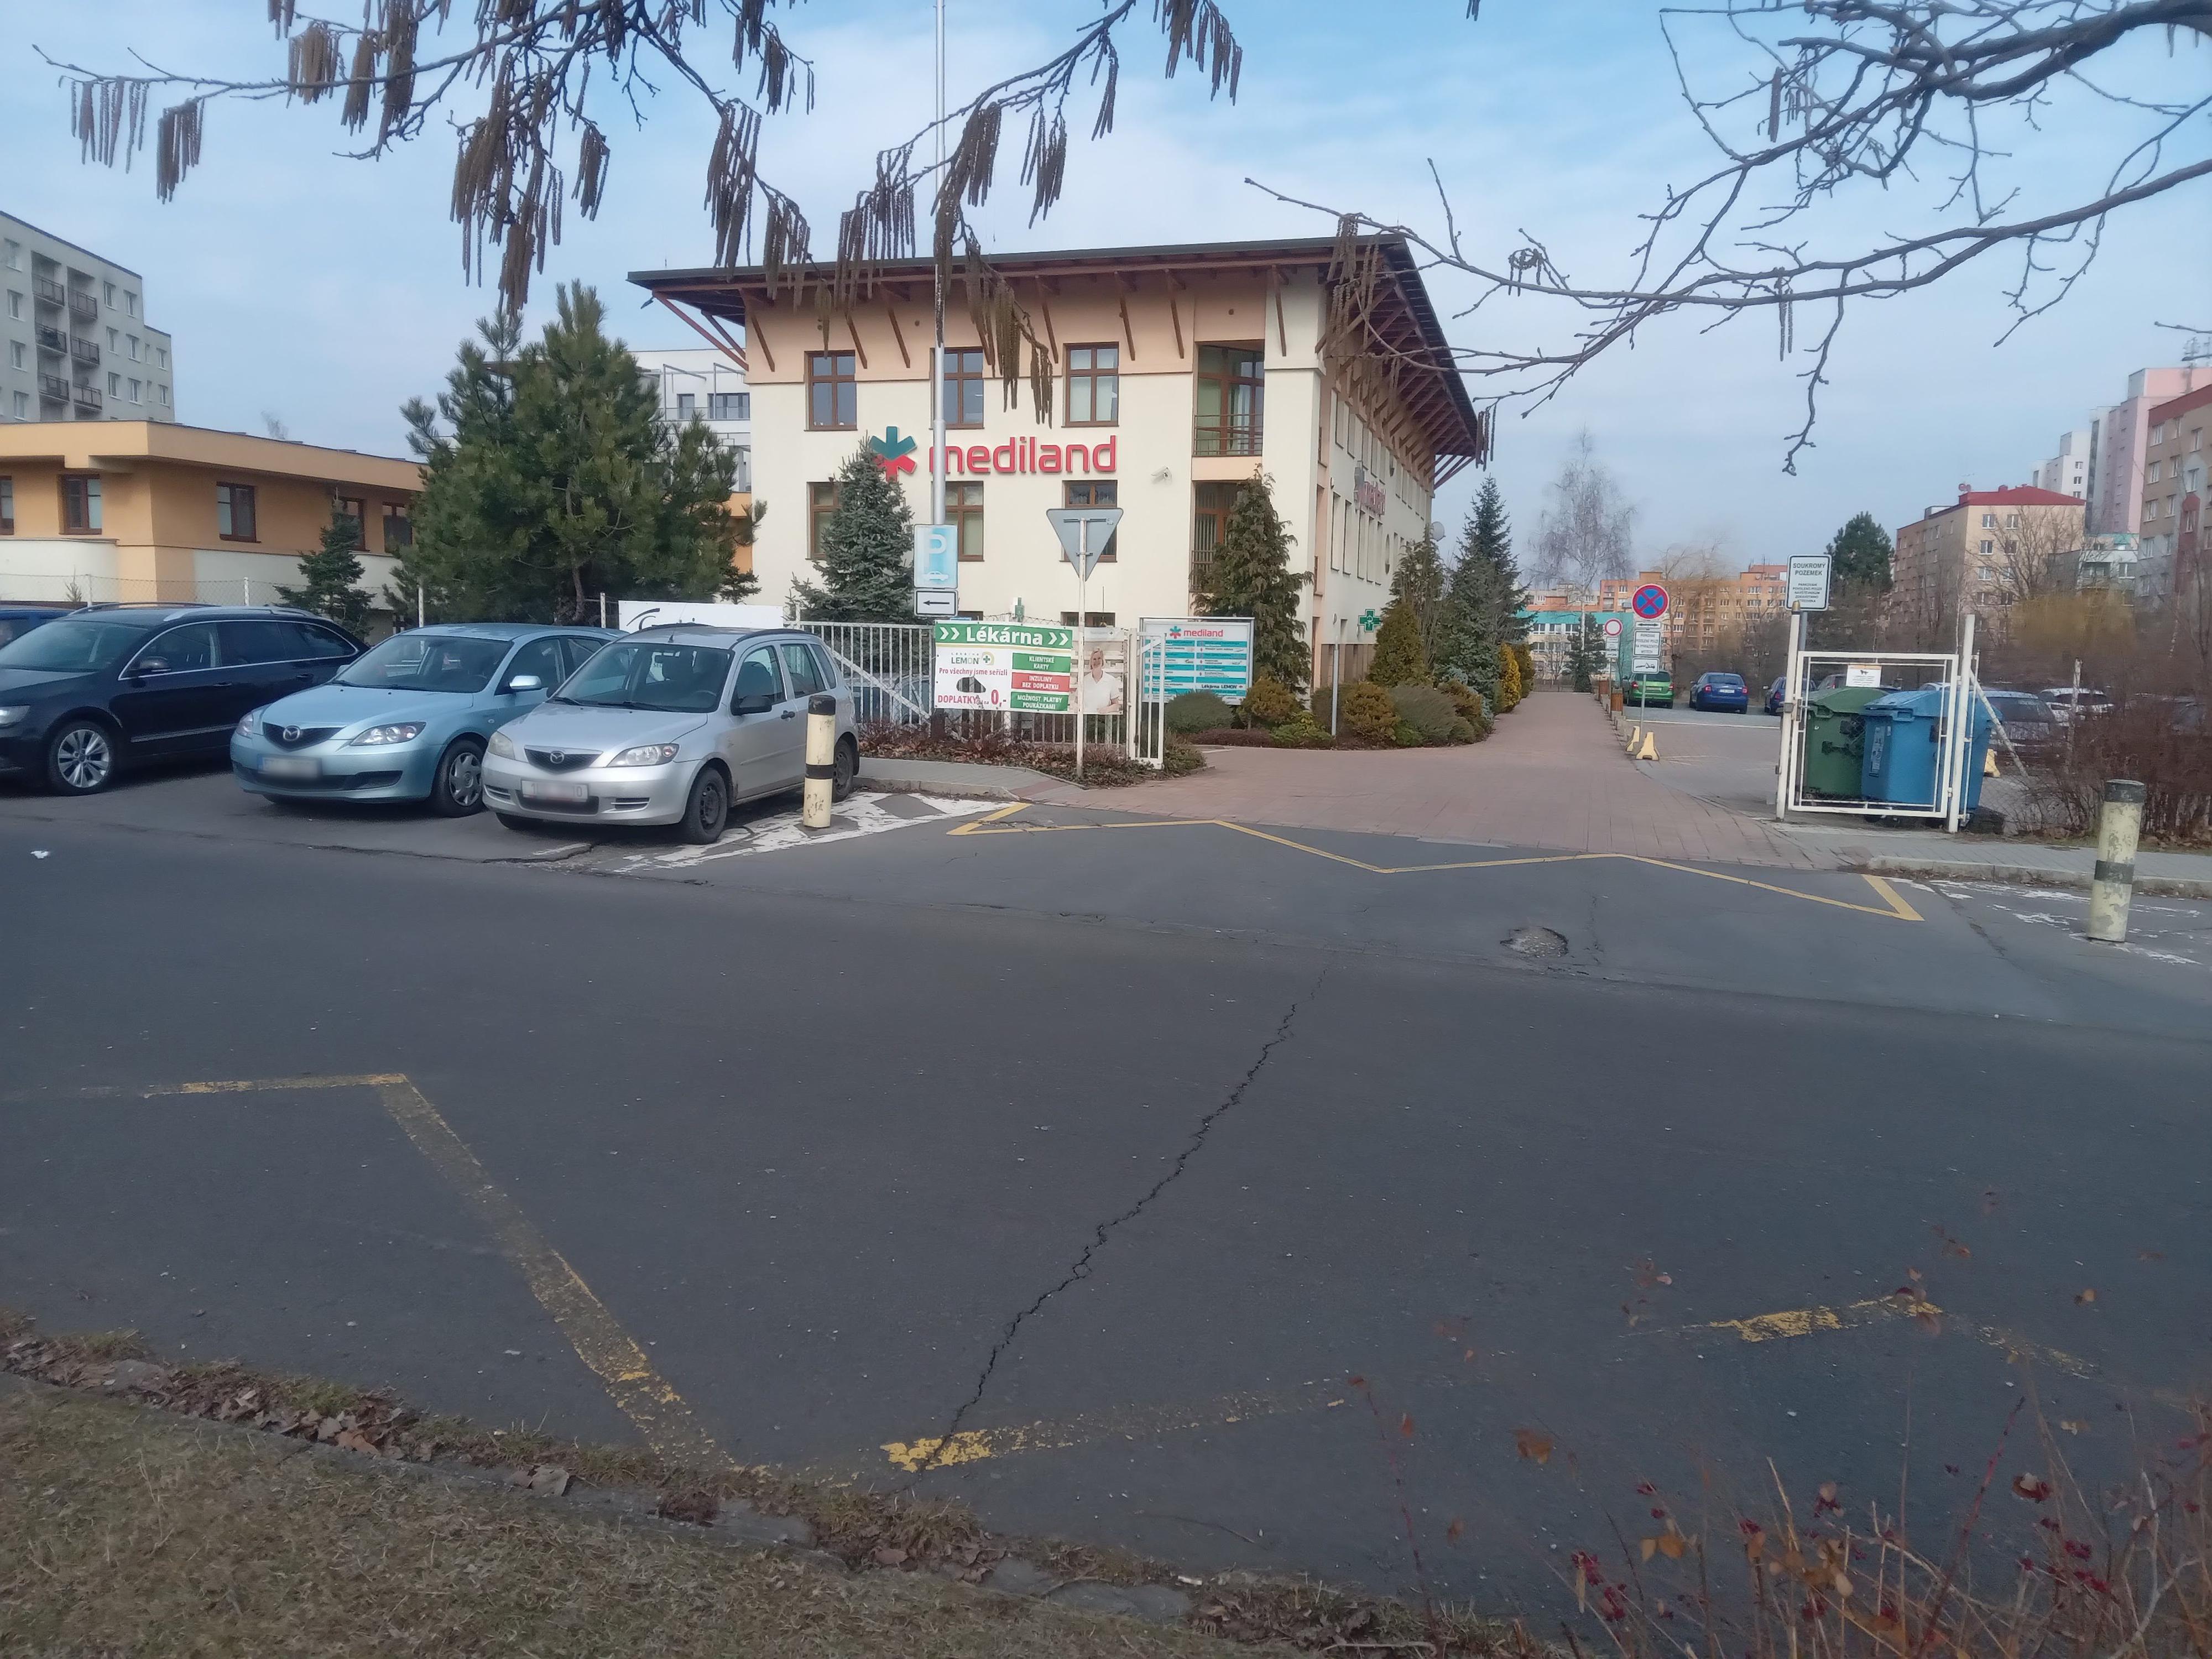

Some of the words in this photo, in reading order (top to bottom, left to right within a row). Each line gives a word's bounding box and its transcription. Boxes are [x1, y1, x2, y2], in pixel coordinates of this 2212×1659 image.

[929, 435, 1116, 473] mediland
[966, 626, 1043, 645] Lékárna
[938, 695, 978, 704] DOPLATKY
